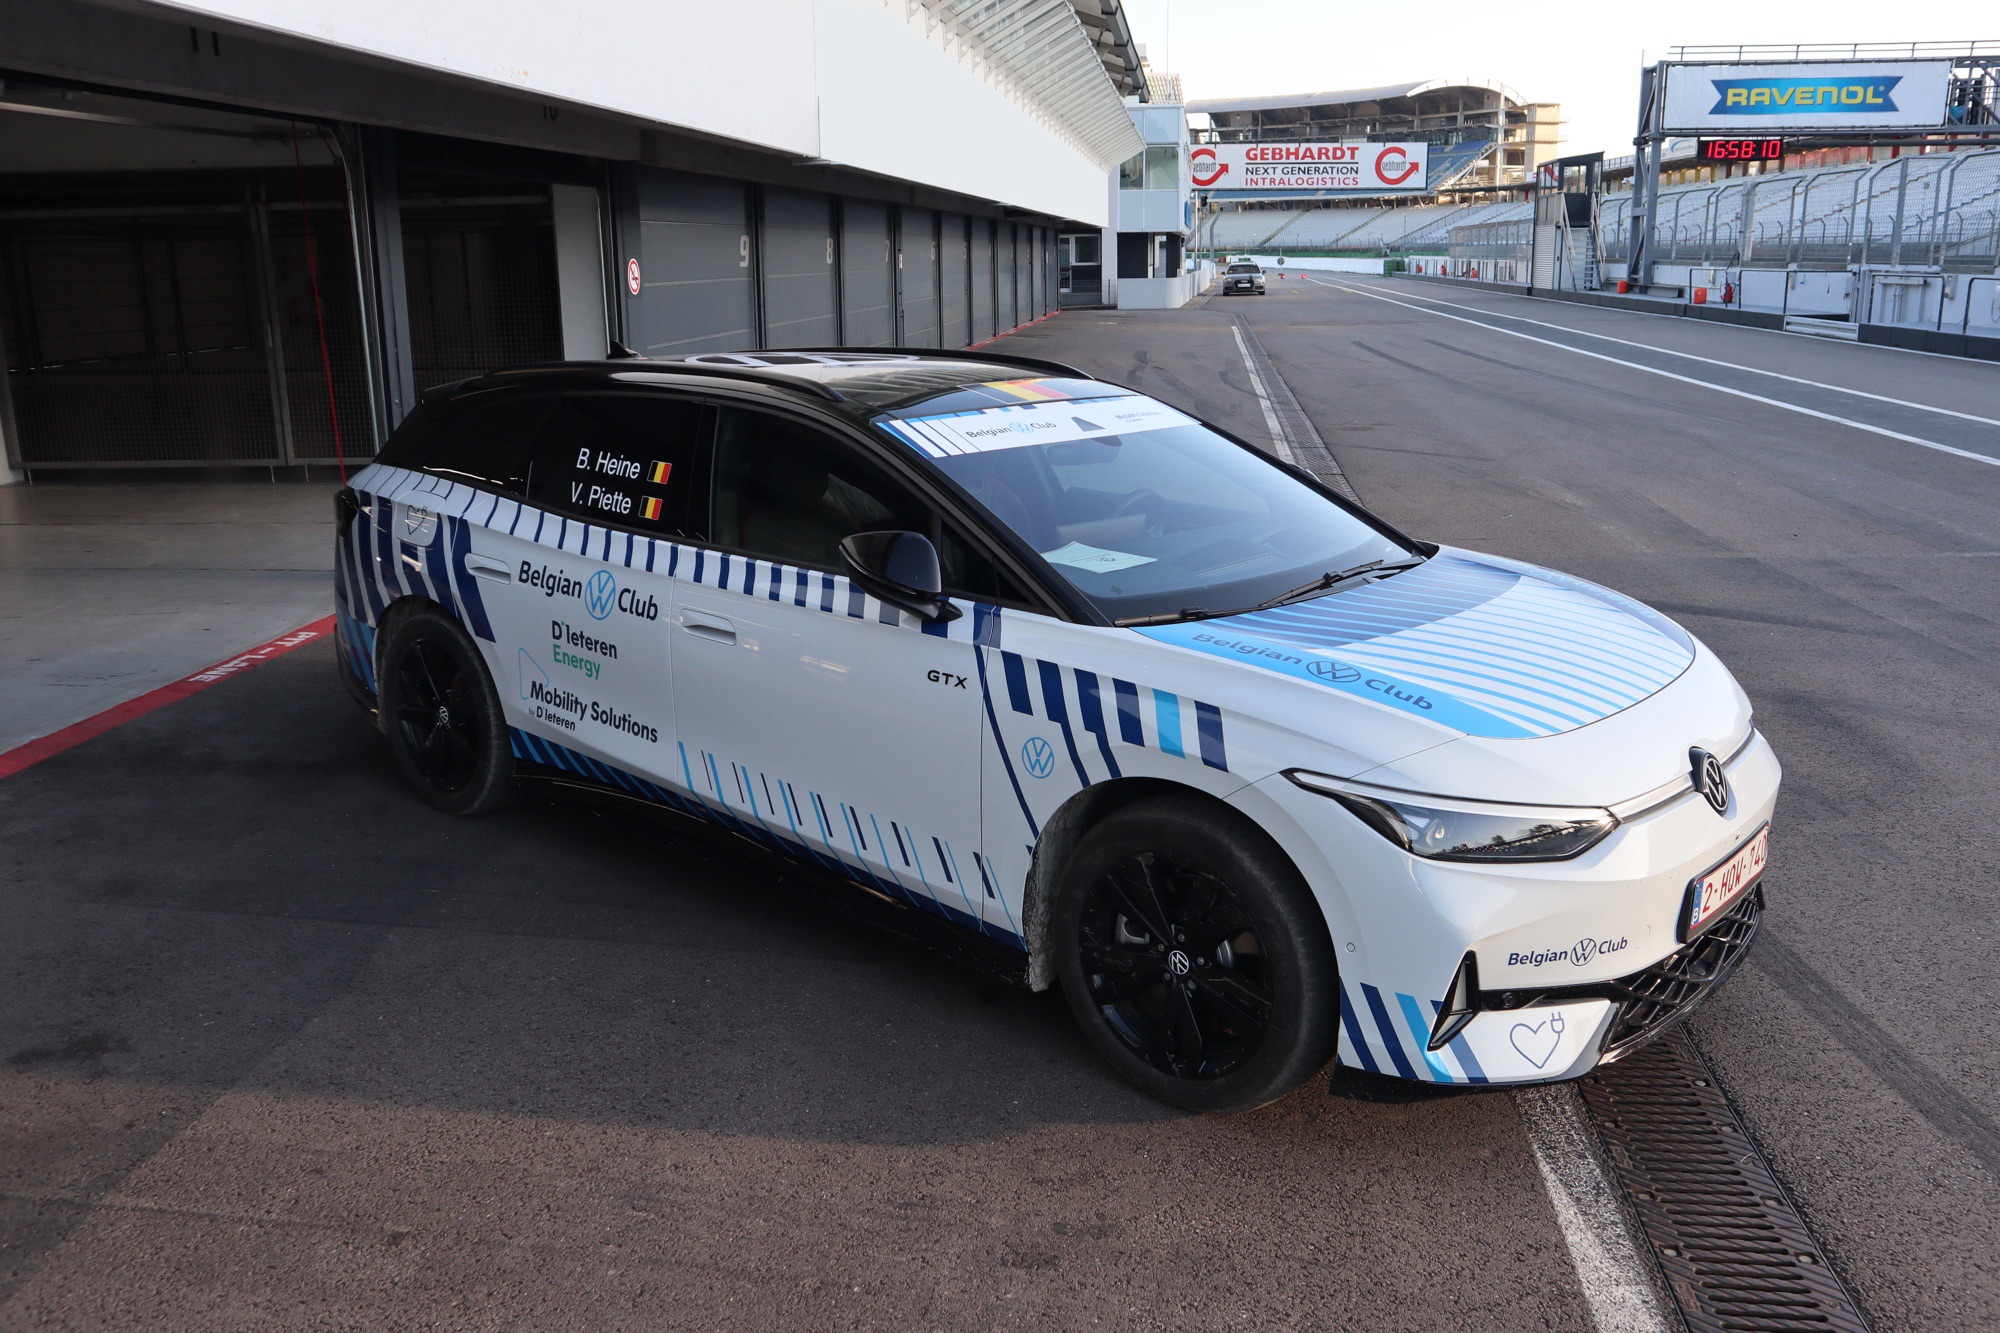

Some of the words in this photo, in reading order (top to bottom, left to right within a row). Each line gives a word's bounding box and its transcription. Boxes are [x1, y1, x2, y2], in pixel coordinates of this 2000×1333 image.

[1726, 86, 1883, 106] RAVENOL
[1245, 147, 1359, 161] GEBHARDT
[1708, 140, 1780, 158] 16:58:10
[1245, 167, 1277, 176] NEXT
[1281, 166, 1359, 176] GENERATION
[1382, 160, 1406, 171] gebhardt
[1245, 177, 1359, 186] INTRALOGISTICS
[740, 235, 750, 268] 9
[826, 238, 834, 264] 8
[966, 427, 1012, 438] Belgian
[1030, 422, 1056, 430] Club
[576, 448, 590, 470] B.
[595, 451, 640, 478] Heine
[571, 482, 583, 504] V.
[588, 486, 632, 514] Piette
[518, 560, 582, 598] Belgian
[618, 588, 658, 621] Club
[552, 644, 600, 680] Energy
[1192, 634, 1302, 664] Belgian
[1364, 679, 1433, 710] Club
[927, 670, 968, 690] GTX
[528, 707, 535, 717] by
[530, 680, 588, 721] Mobility
[590, 701, 658, 742] Solutions
[1693, 908, 1698, 922] B
[1507, 948, 1568, 966] Belgian
[1598, 936, 1628, 955] Club
